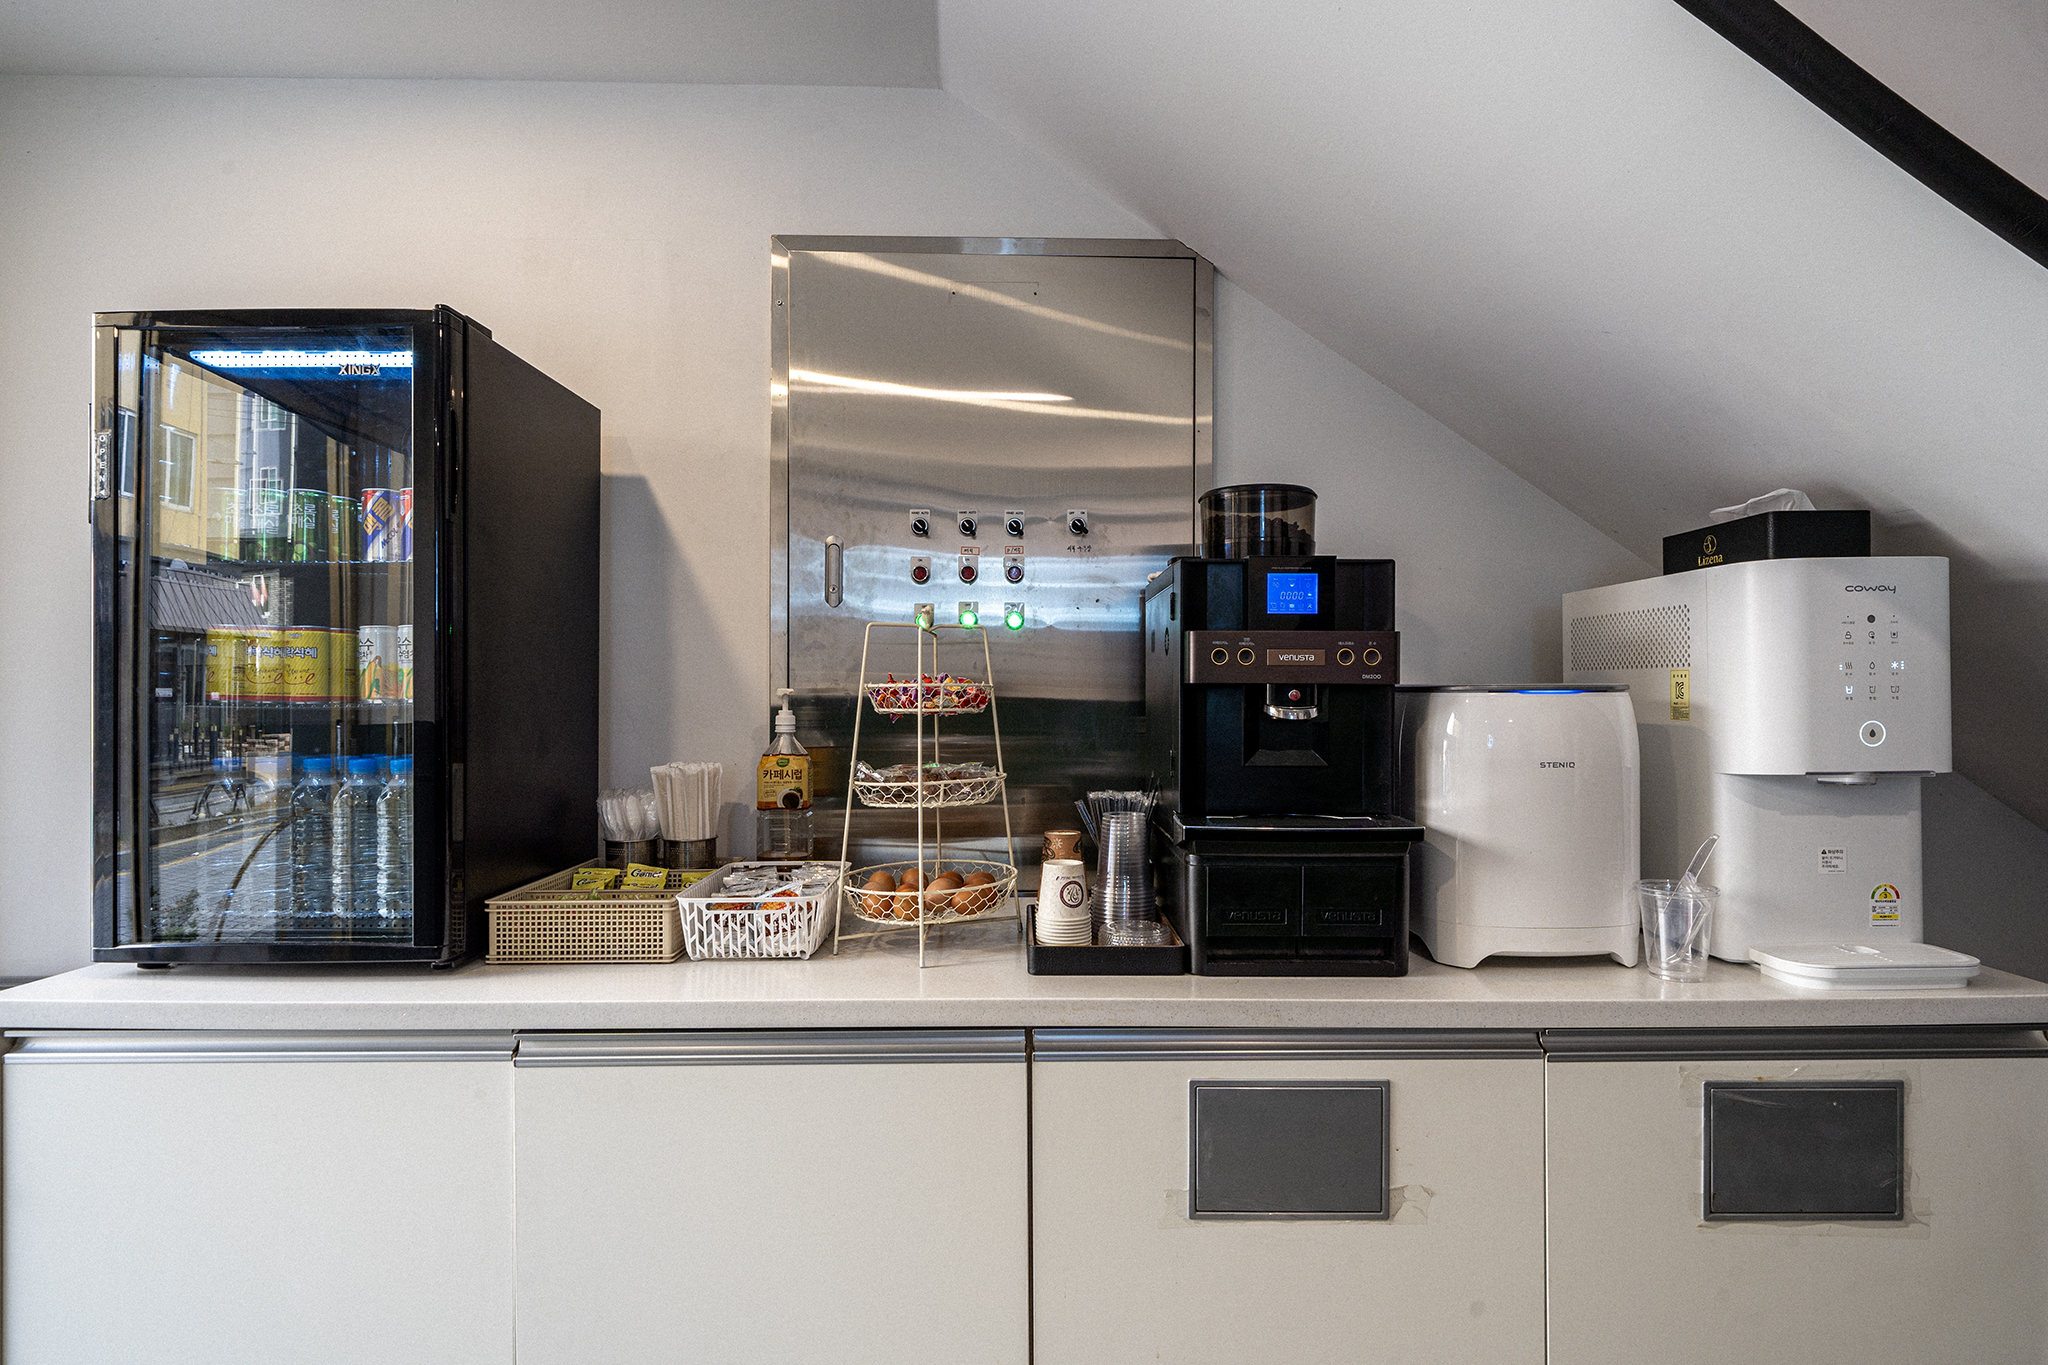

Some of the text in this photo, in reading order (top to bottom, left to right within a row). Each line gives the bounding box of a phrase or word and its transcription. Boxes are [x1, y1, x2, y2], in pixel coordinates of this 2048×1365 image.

[338, 364, 381, 376] XINGX
[1697, 554, 1724, 567] Lizena
[1539, 761, 1576, 769] STENIQ
[763, 769, 803, 780] 카페시럽
